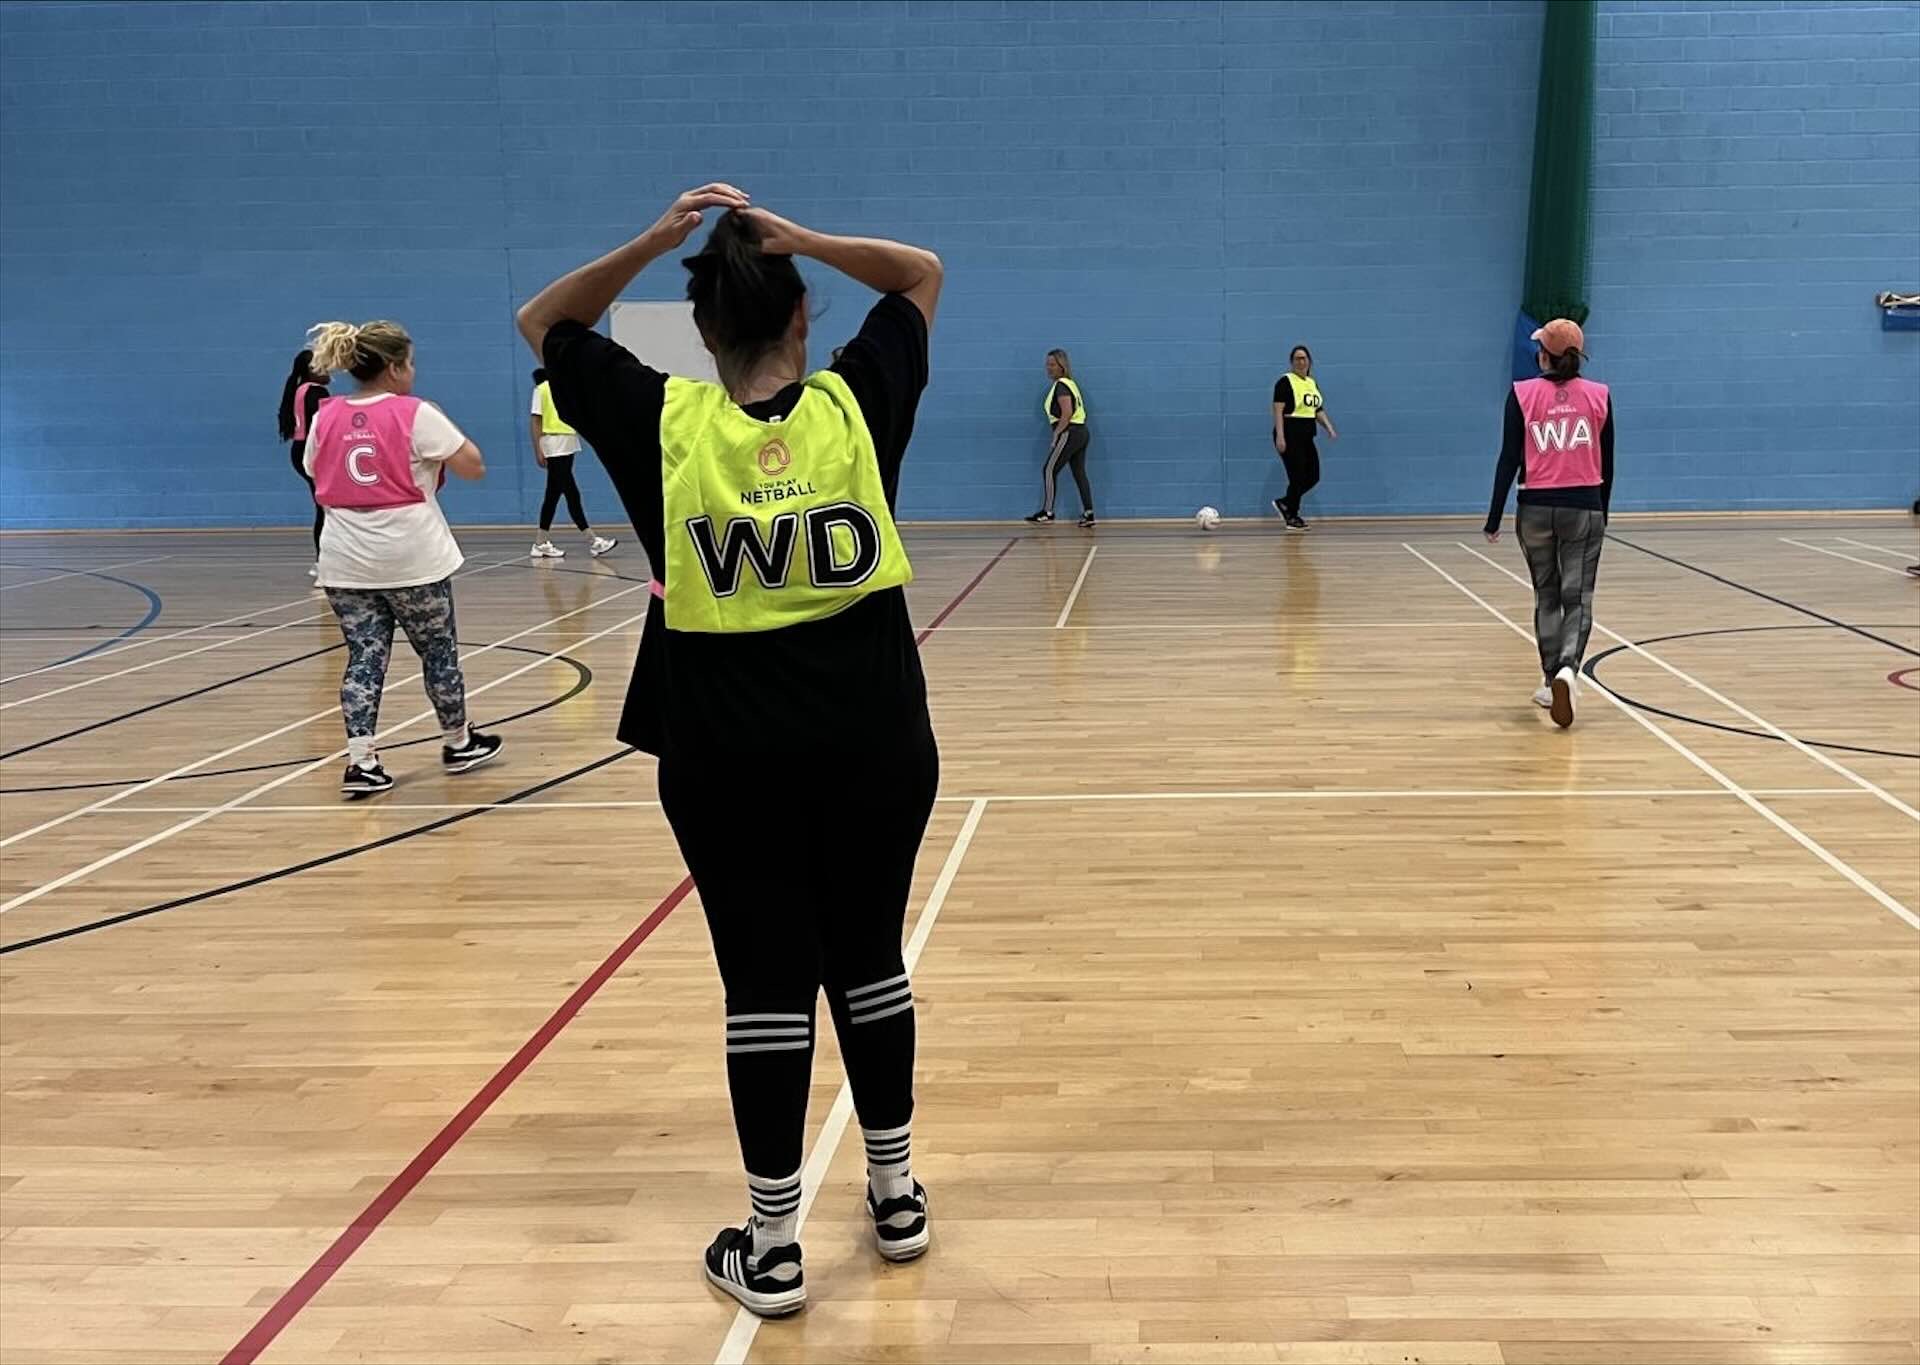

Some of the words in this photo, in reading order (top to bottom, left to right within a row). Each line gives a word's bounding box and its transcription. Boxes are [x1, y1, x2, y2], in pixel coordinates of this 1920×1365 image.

[1303, 393, 1320, 407] GD
[1529, 416, 1593, 455] WA
[345, 444, 380, 486] C
[741, 482, 816, 504] NETBALL
[776, 478, 797, 487] PLAY
[686, 501, 881, 598] WD
